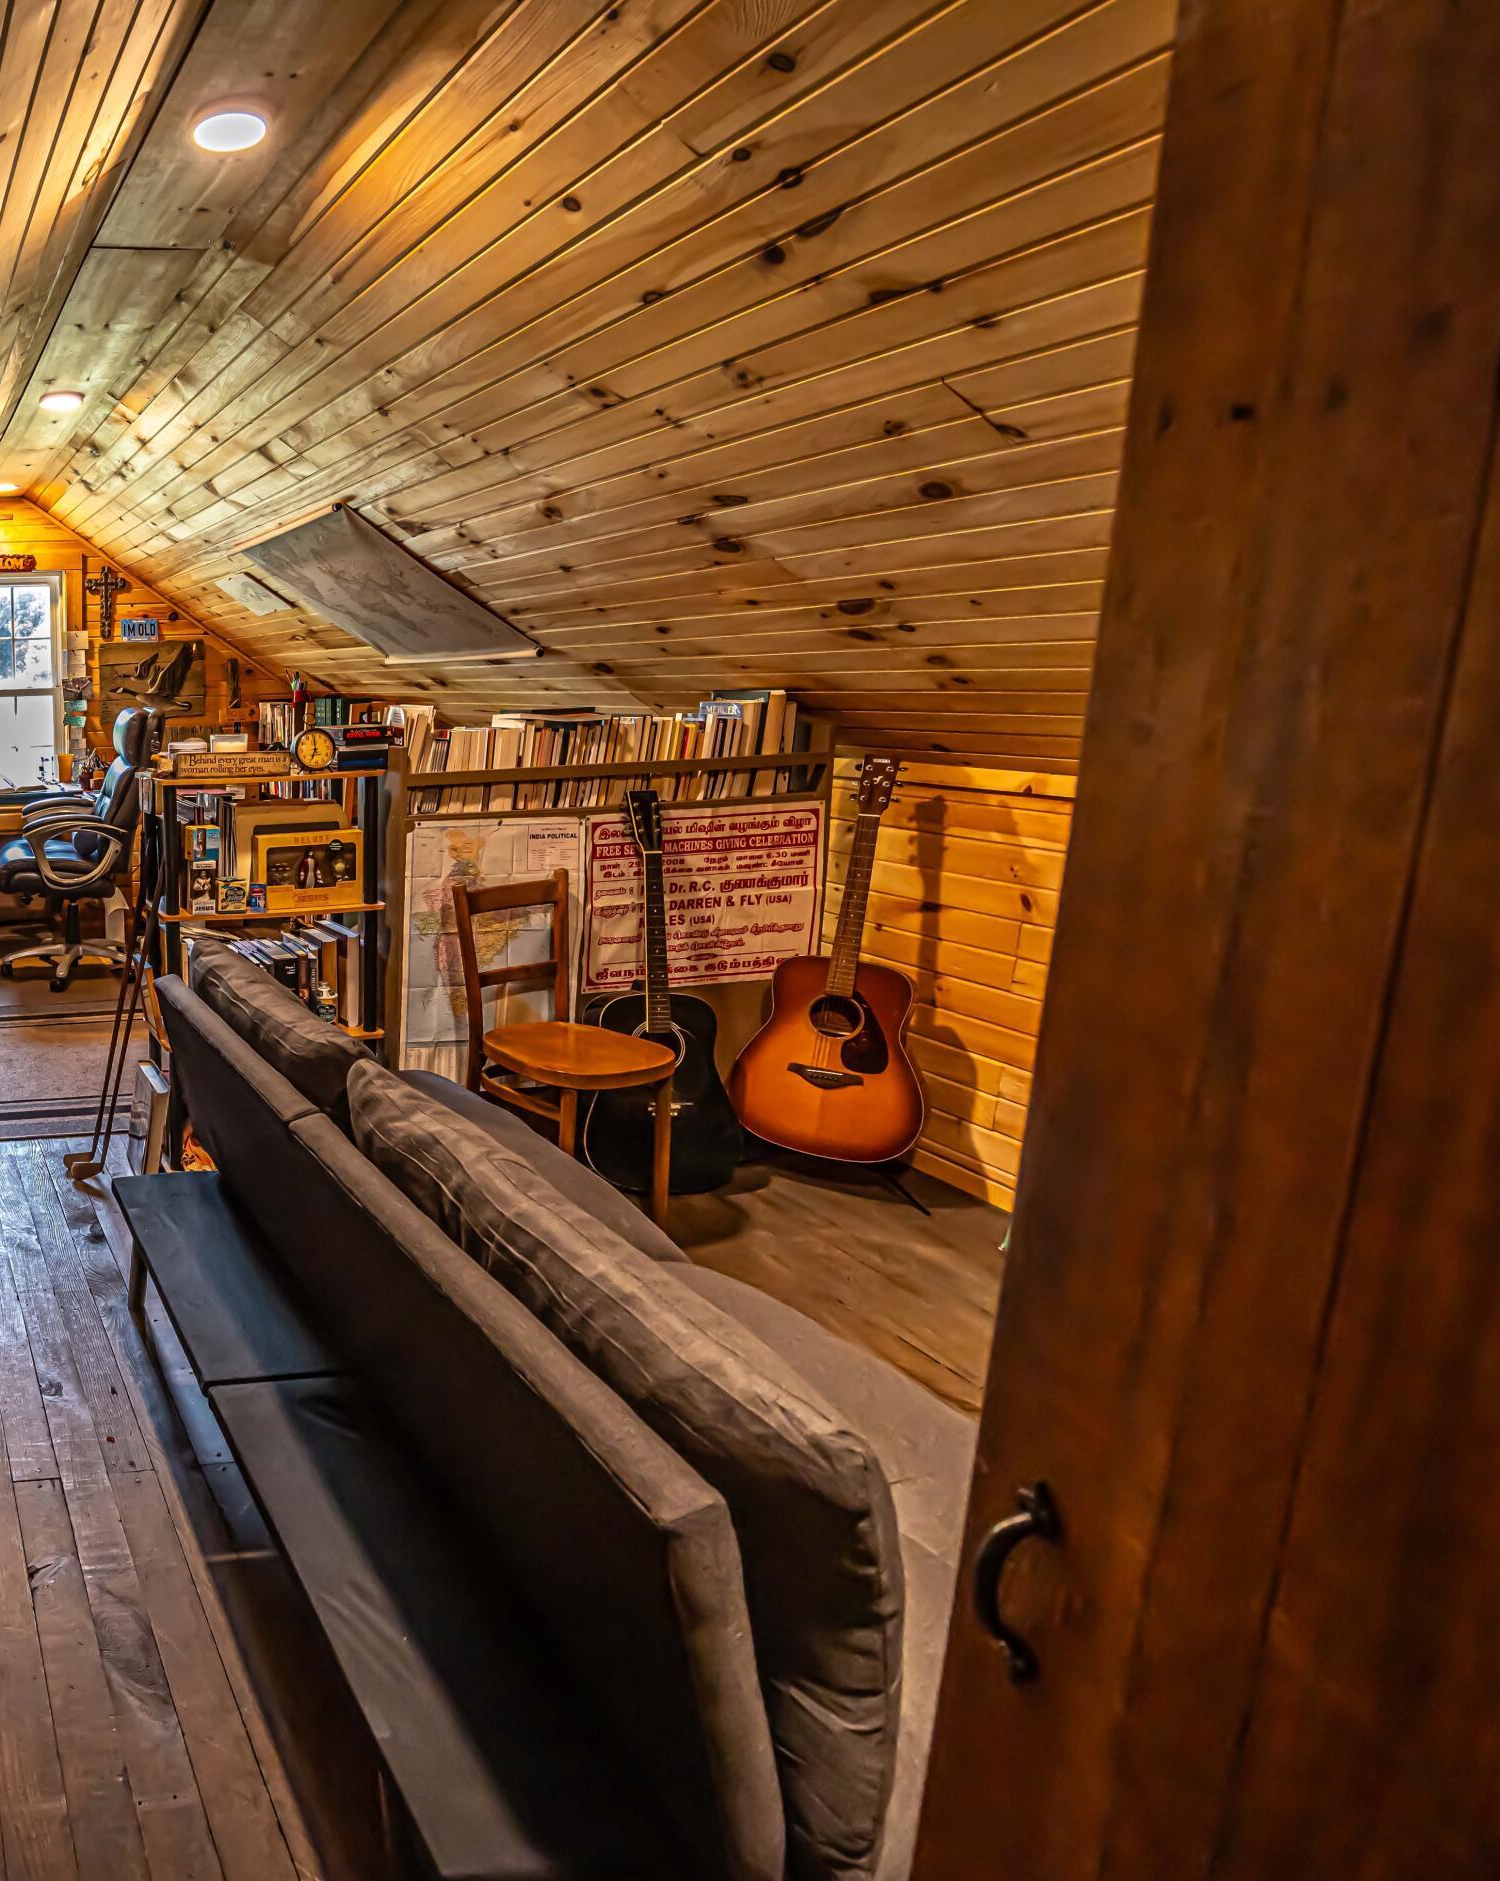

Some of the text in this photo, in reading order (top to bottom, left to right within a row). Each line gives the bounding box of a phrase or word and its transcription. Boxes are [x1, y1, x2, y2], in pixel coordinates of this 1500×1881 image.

[123, 623, 156, 637] IM OLD
[189, 754, 217, 767] Behind
[218, 757, 237, 766] every
[238, 756, 257, 765] great
[210, 764, 234, 776] rolling
[234, 764, 247, 773] her
[596, 845, 622, 857] FREE
[664, 839, 713, 853] MACHINES
[715, 837, 747, 850] GIVING
[749, 832, 814, 849] CELEBRATION
[766, 851, 788, 859] 6.30
[669, 881, 686, 894] Dr.
[689, 880, 715, 893] R.C.
[669, 894, 792, 911] DARREN & FLY (USA)
[689, 913, 715, 926] (USA)
